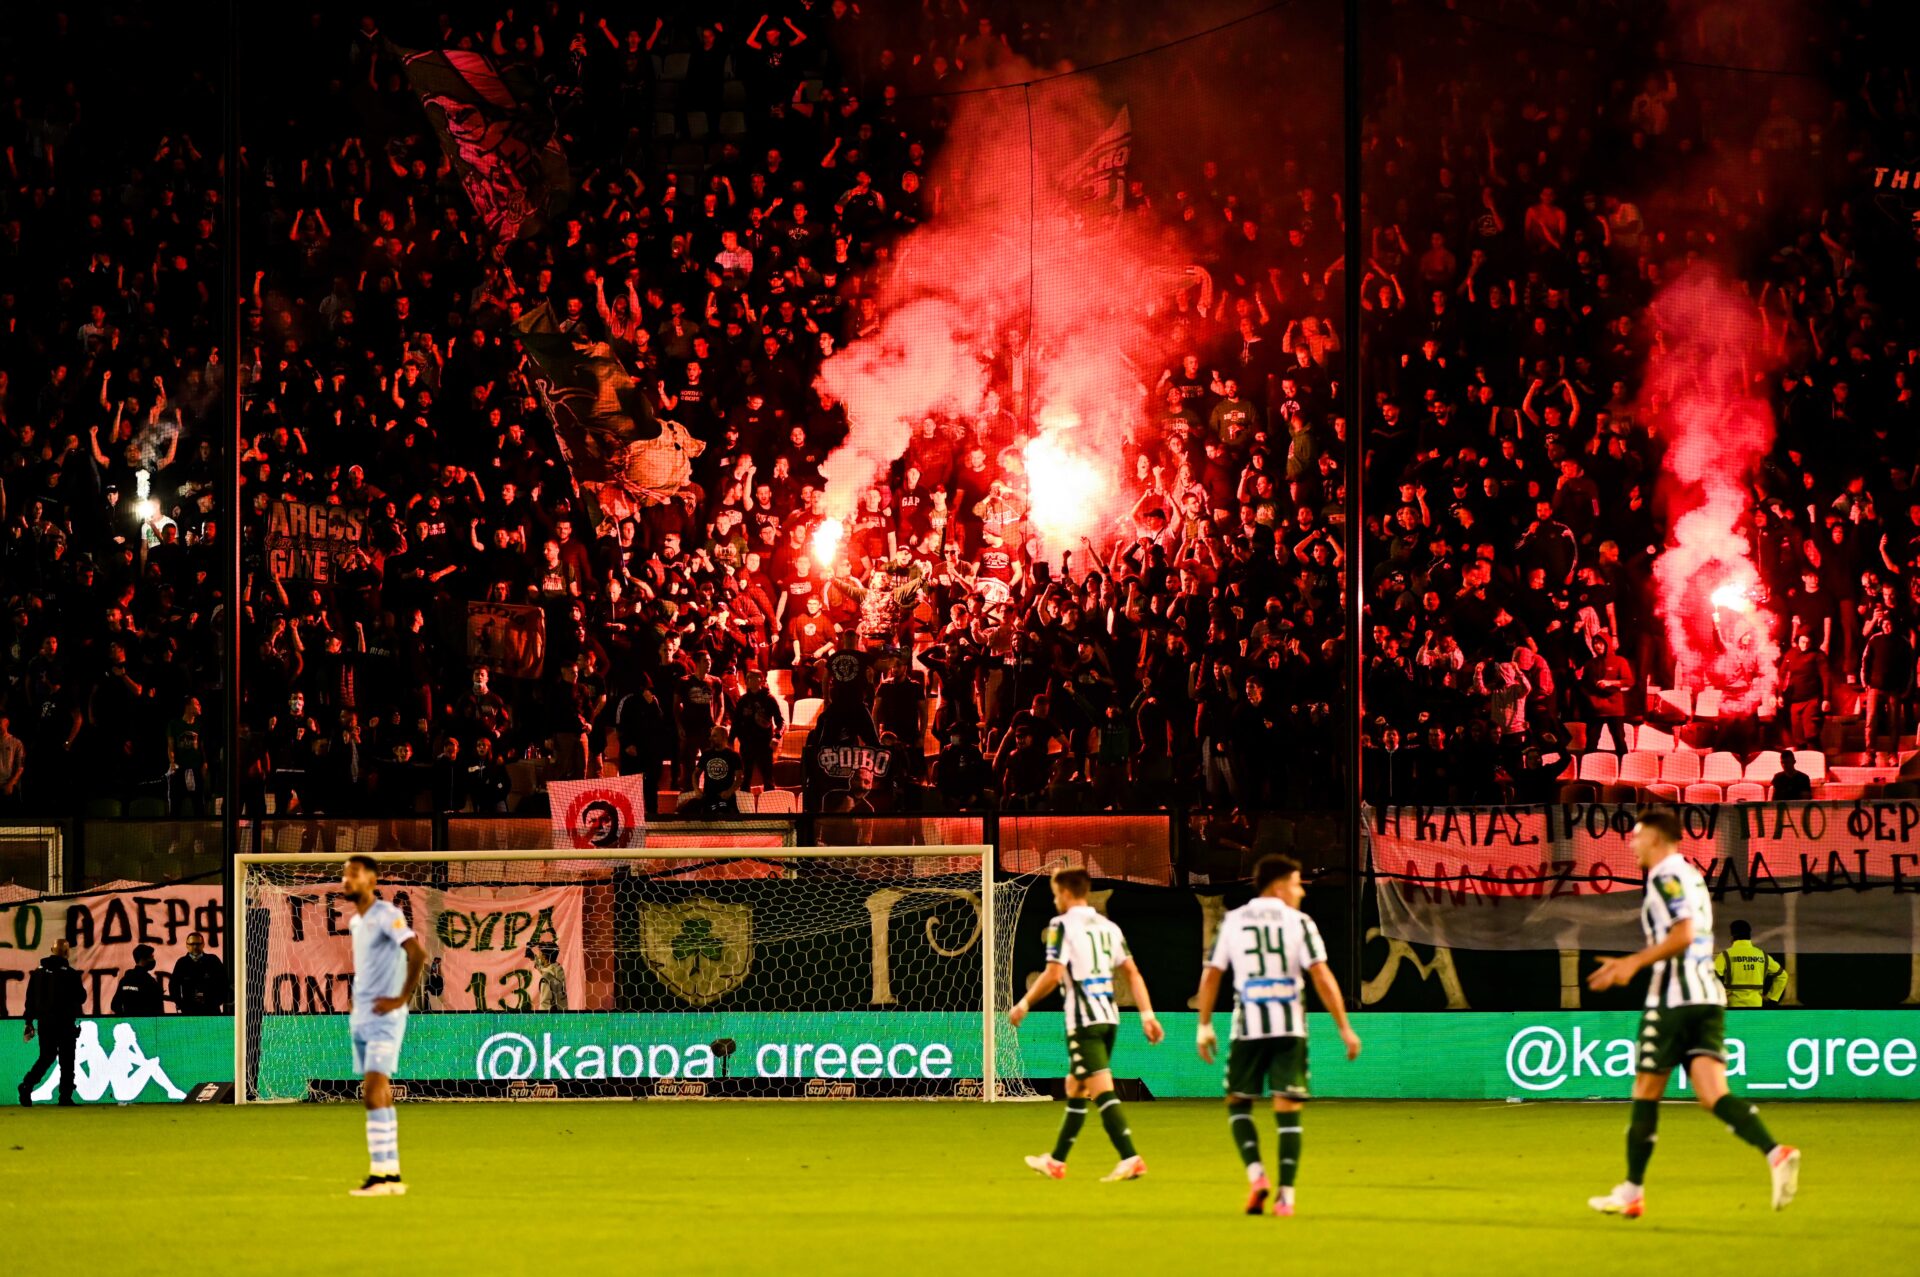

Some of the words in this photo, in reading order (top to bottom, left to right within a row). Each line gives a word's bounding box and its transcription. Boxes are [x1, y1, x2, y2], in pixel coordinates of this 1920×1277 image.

[270, 500, 364, 541] ARGOS
[902, 496, 920, 507] GAP
[270, 549, 328, 581] GATE
[1414, 803, 1653, 846] ΚΑΤΑΣΤΡΟΦ
[1735, 802, 1826, 840] ΠΑΟ
[436, 906, 559, 951] ΘΥΡΑ
[1086, 931, 1112, 974] 14
[1242, 925, 1288, 977] 34
[465, 970, 543, 1012] 13
